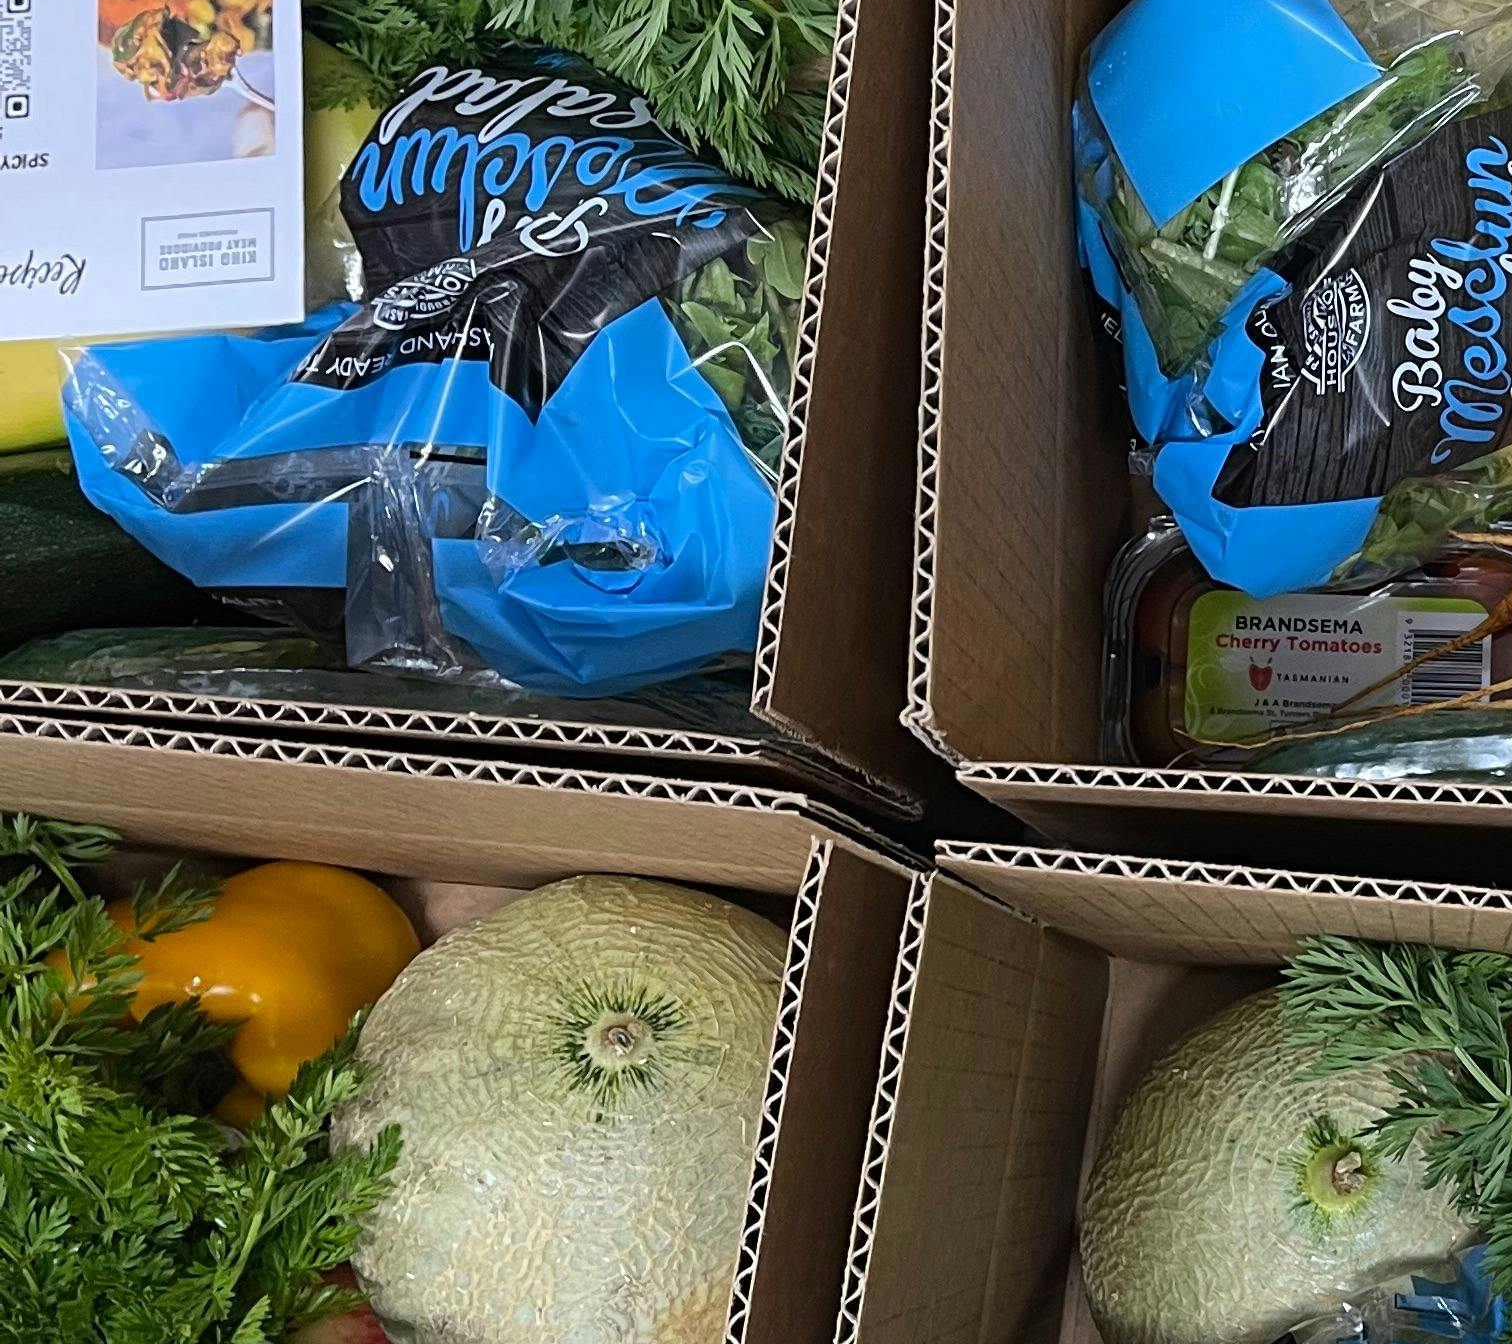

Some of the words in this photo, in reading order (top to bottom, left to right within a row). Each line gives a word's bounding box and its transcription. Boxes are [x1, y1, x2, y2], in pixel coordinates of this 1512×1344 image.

[226, 237, 257, 251] MEAT
[159, 254, 214, 272] ISLAND
[220, 250, 257, 266] KING
[1345, 285, 1367, 347] FARM
[1386, 253, 1463, 412] Baby
[1235, 616, 1363, 637] BRANDSEMA
[1215, 633, 1281, 653] Cherry
[1287, 636, 1383, 654] Tomatoes
[1276, 673, 1350, 684] TASMANIAN
[1272, 699, 1279, 707] A
